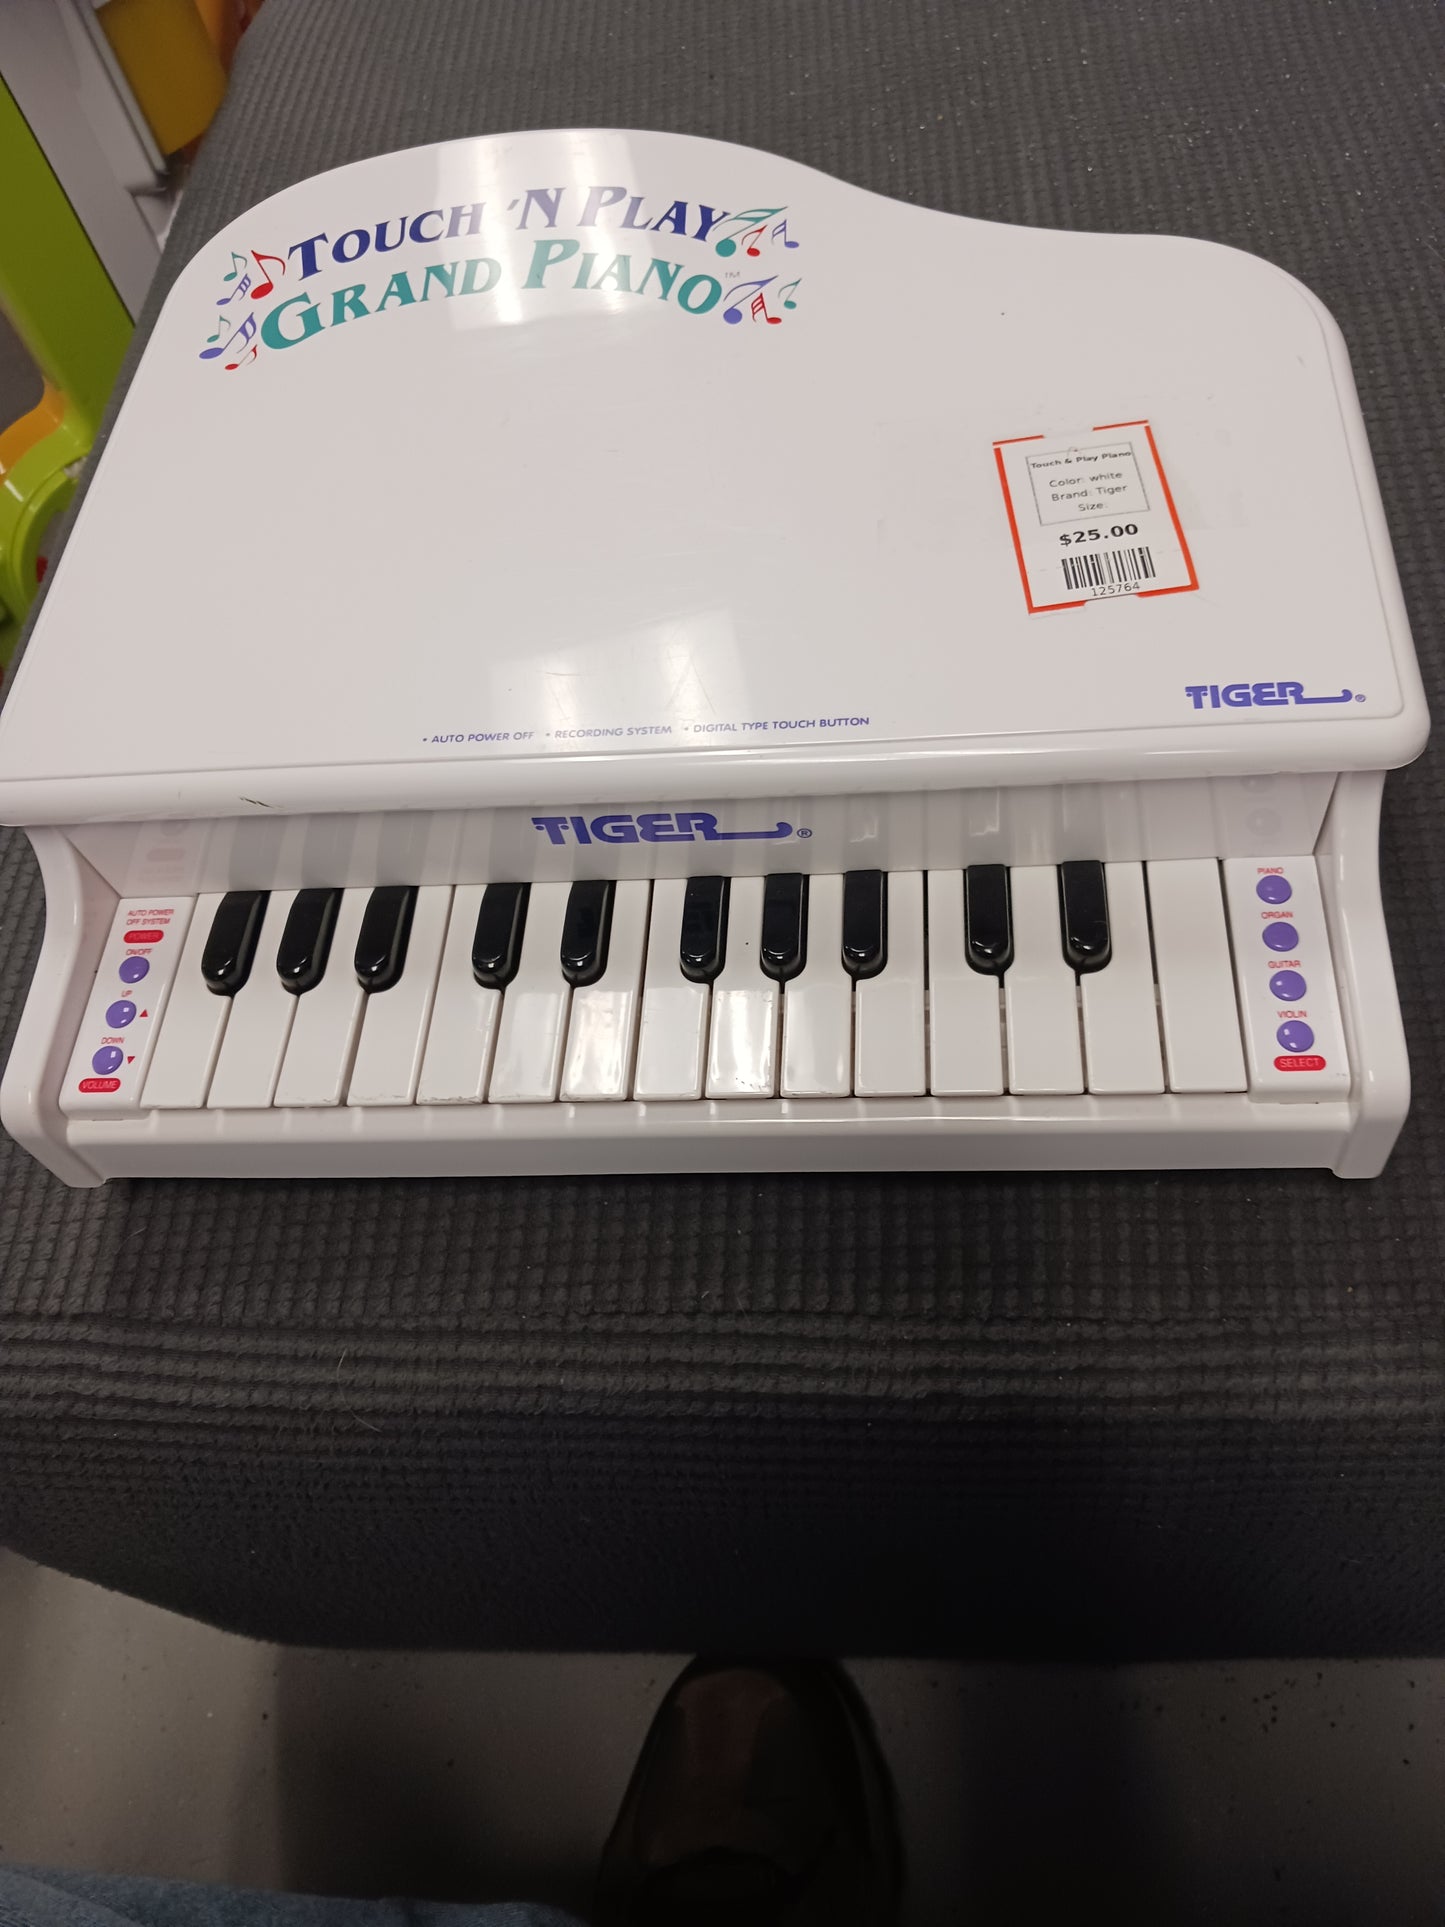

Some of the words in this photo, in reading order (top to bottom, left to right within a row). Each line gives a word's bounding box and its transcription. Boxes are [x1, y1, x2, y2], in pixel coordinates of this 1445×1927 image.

[288, 201, 485, 281] TOUCH
[577, 186, 731, 242] PLAY
[260, 256, 501, 350] GRAND
[521, 239, 722, 315] PIANO
[1031, 459, 1062, 469] Touch
[1076, 455, 1099, 463] Play
[1102, 451, 1132, 460] Piano
[1089, 471, 1123, 482] white
[1096, 484, 1128, 496] Tiger
[1059, 523, 1139, 547] $25.00
[1091, 581, 1141, 597] 125764
[1185, 681, 1353, 709] TIGER
[693, 723, 738, 733] DIGITAL
[741, 722, 769, 731] TYPE
[772, 719, 816, 729] TOUCH
[819, 717, 870, 727] BUTTON
[431, 734, 465, 743] AUTO
[467, 732, 509, 742] POWER
[513, 731, 535, 740] OFF
[554, 728, 623, 739] RECORDING
[626, 725, 672, 735] SYSTEM
[531, 812, 793, 845] TIGER
[127, 909, 147, 917] AUTO
[141, 918, 171, 926] SYSTEM
[121, 990, 132, 998] UP
[101, 1036, 125, 1044] DOWN
[1278, 1058, 1321, 1069] SELECT
[82, 1079, 117, 1090] VOLUME
